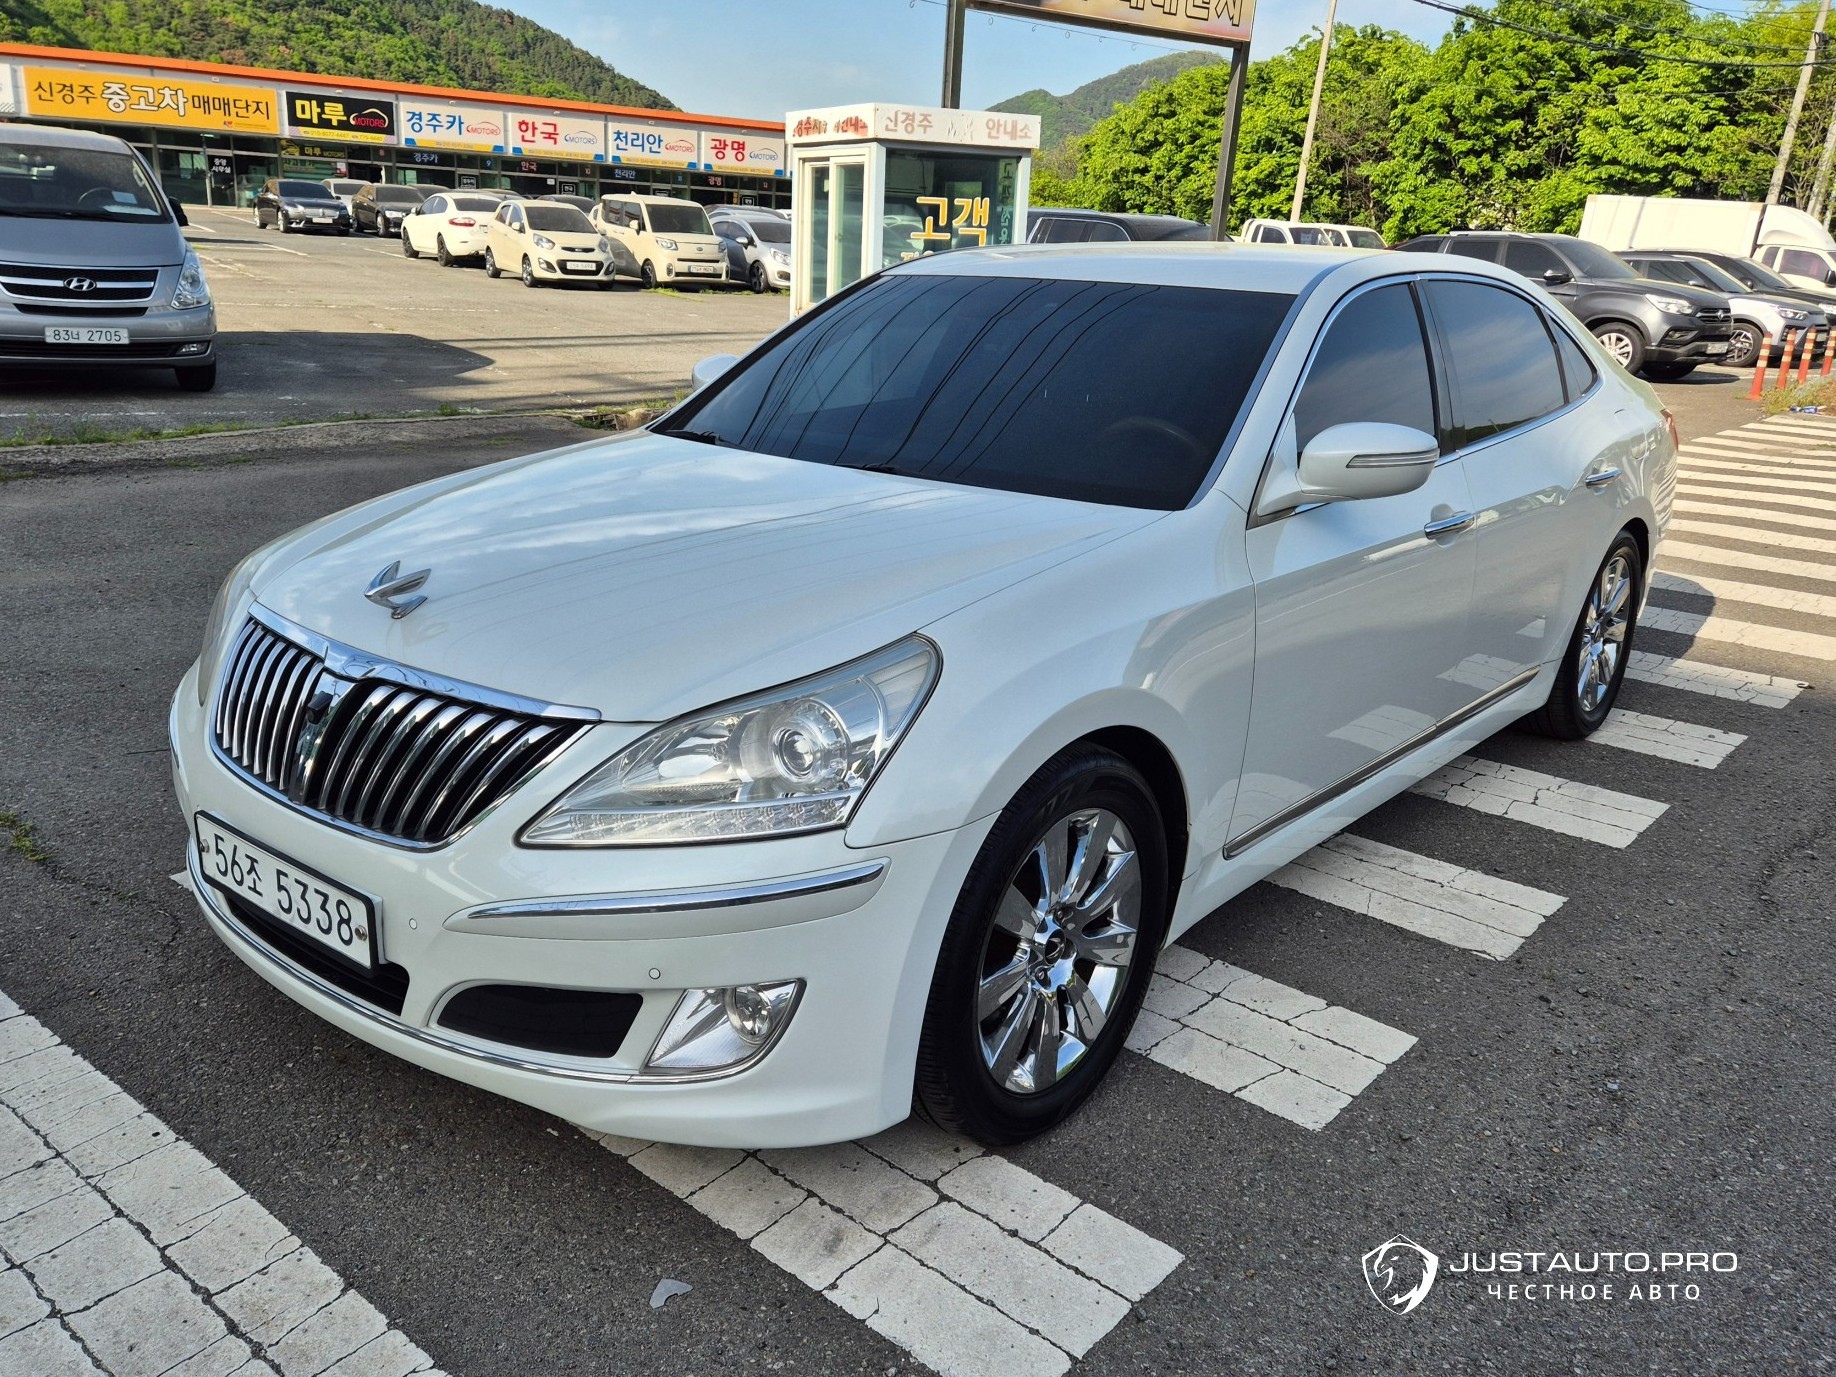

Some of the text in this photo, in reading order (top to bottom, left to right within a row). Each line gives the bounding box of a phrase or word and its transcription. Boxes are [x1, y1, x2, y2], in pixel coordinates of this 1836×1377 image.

[34, 82, 270, 120] 신경주 중고차 매매단지
[295, 99, 347, 126] 마루
[354, 117, 385, 128] MOTORS
[406, 111, 464, 135] 경주카
[885, 110, 933, 134] 신경주
[986, 118, 1033, 141] 안내소
[470, 127, 499, 136] MOTORS
[518, 120, 559, 145] 한국
[568, 136, 595, 144] MOTORS
[613, 130, 663, 153] 천리안
[304, 147, 322, 156] 마루
[668, 145, 693, 153] MOTORS
[710, 138, 745, 162] 광명
[413, 152, 439, 163] 경주카
[752, 153, 777, 161] MOTORS
[521, 161, 537, 171] 한국
[614, 168, 636, 179] 천리안
[708, 176, 722, 186] 광명
[910, 196, 990, 247] 고객
[87, 329, 122, 342] 2705
[214, 833, 354, 946] 56조 5338
